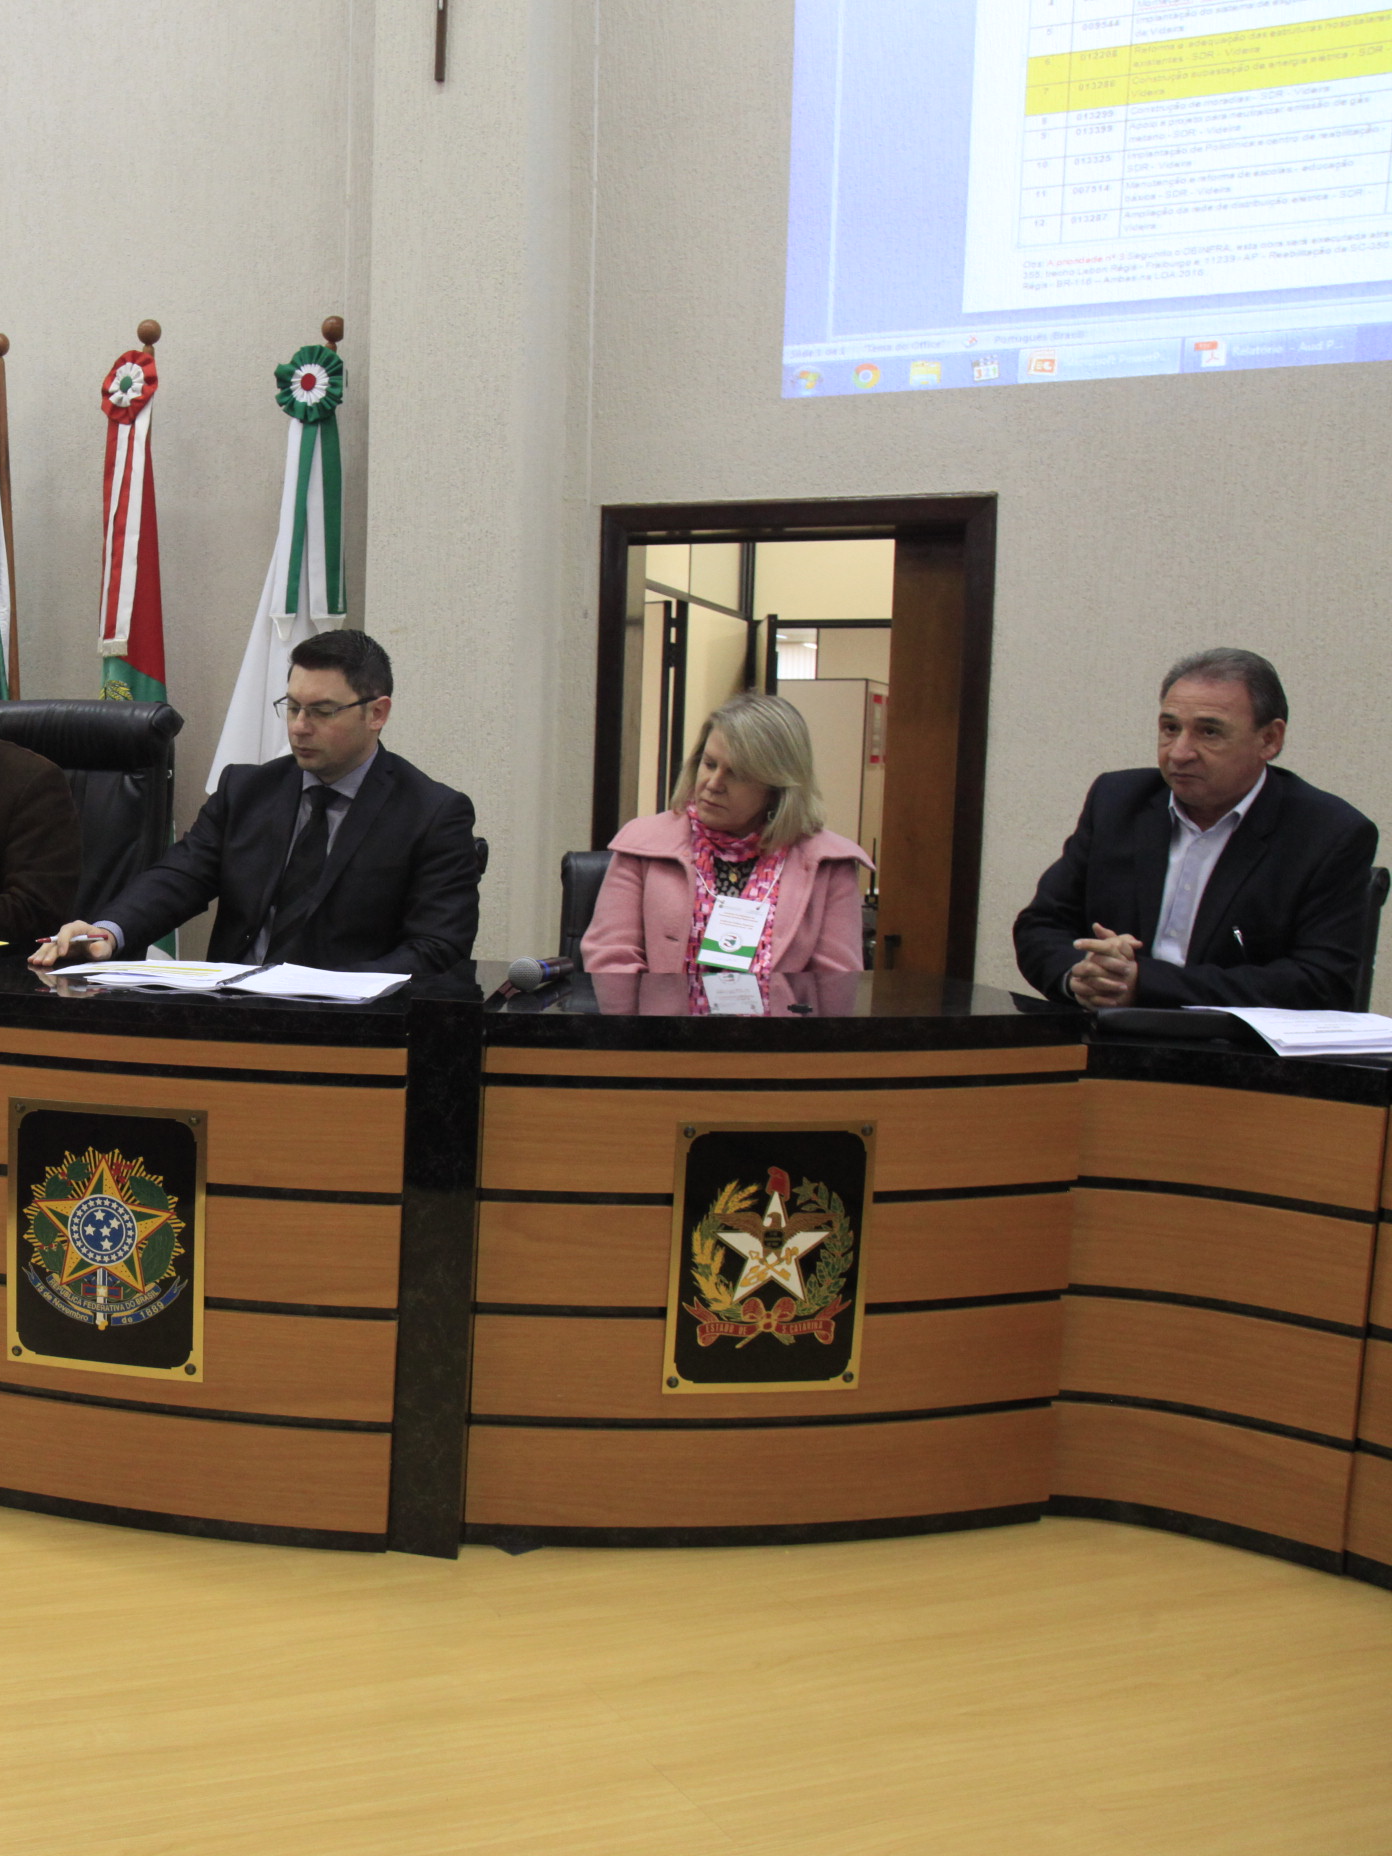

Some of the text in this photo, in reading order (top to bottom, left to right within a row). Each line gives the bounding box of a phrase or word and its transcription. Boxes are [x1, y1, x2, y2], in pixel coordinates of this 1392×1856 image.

[43, 1290, 52, 1300] de
[52, 1296, 89, 1321] Novembro
[83, 1300, 125, 1312] FEDERATIVA
[126, 1301, 135, 1309] DO
[136, 1290, 159, 1305] BRASIL
[122, 1302, 165, 1324] de 1889
